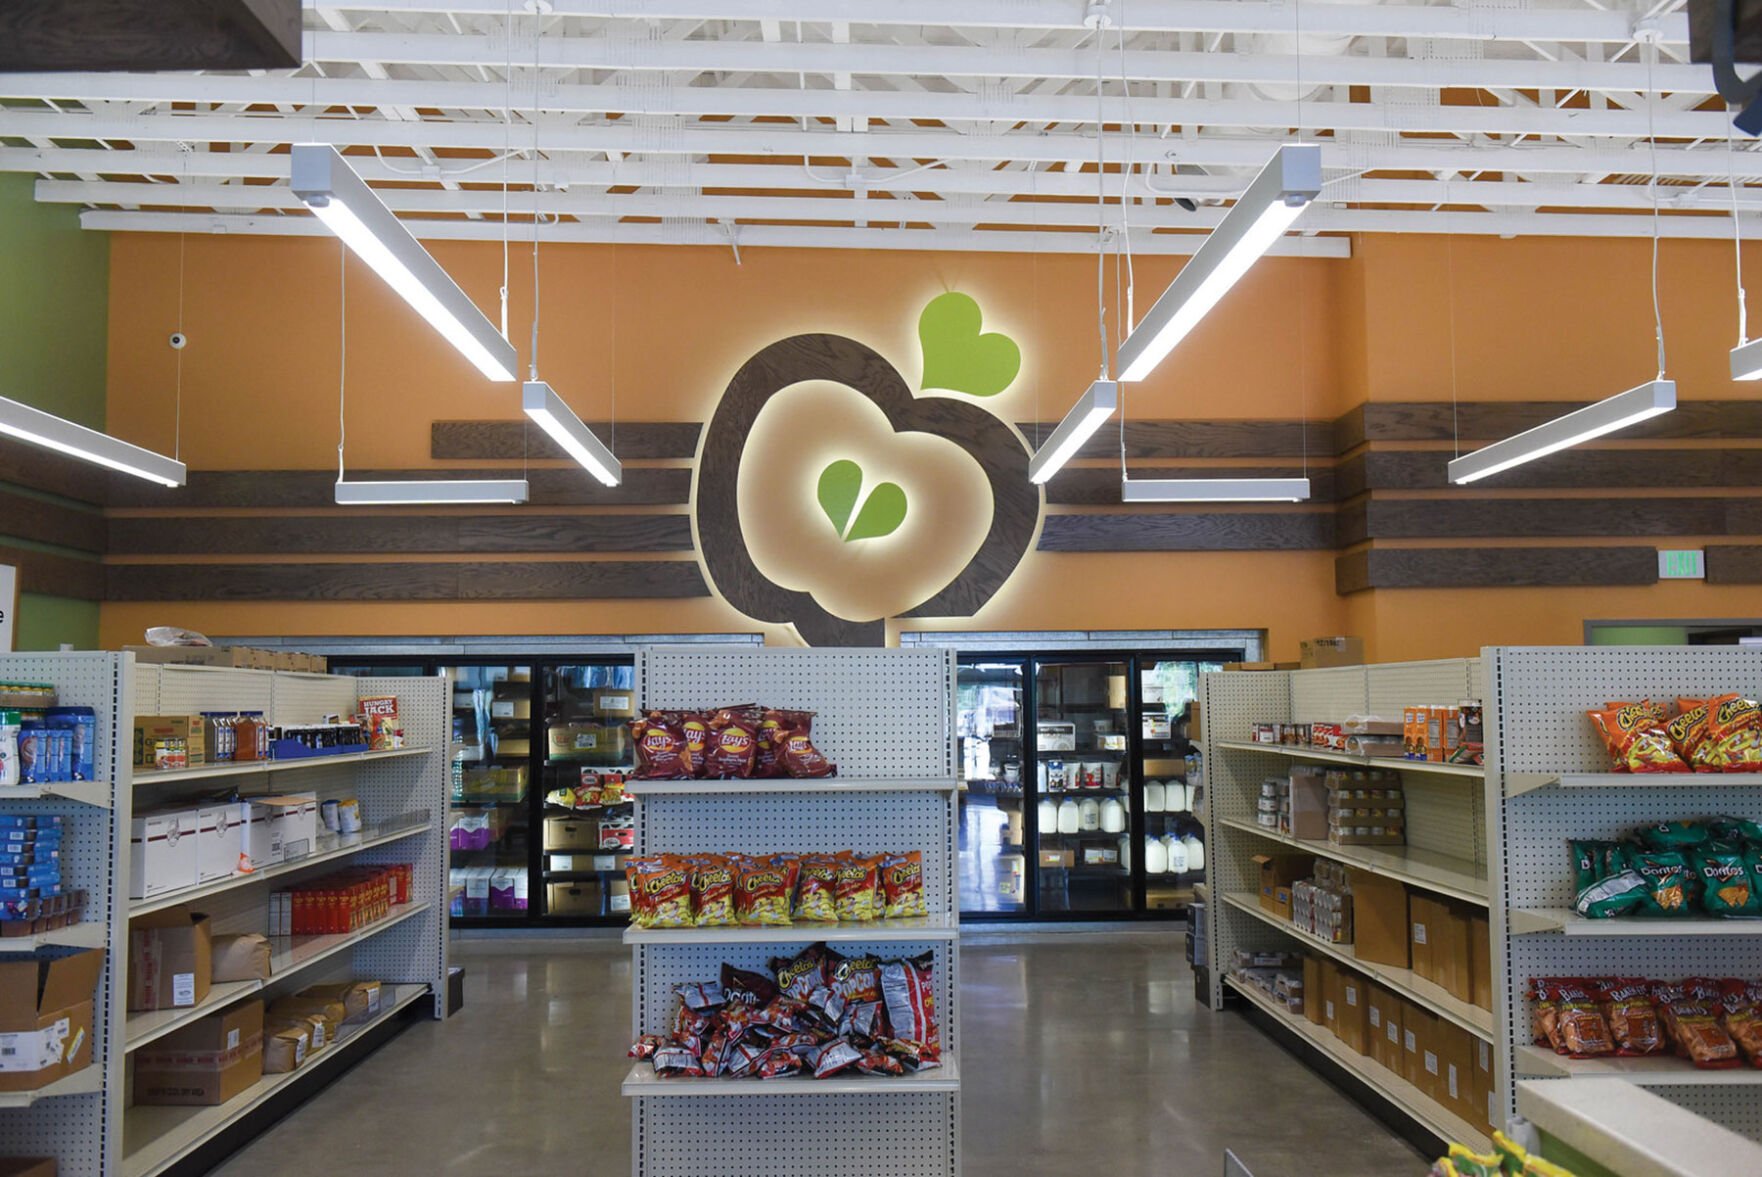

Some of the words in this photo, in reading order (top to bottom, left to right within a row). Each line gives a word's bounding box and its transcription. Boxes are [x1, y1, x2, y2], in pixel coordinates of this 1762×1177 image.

[1666, 551, 1697, 576] EXIT
[364, 705, 395, 718] JACK
[721, 733, 748, 747] Lay's
[1641, 864, 1683, 877] Doritos
[1704, 865, 1744, 878] Doritos
[649, 870, 687, 894] Cheetos
[777, 959, 815, 989] Cheetos
